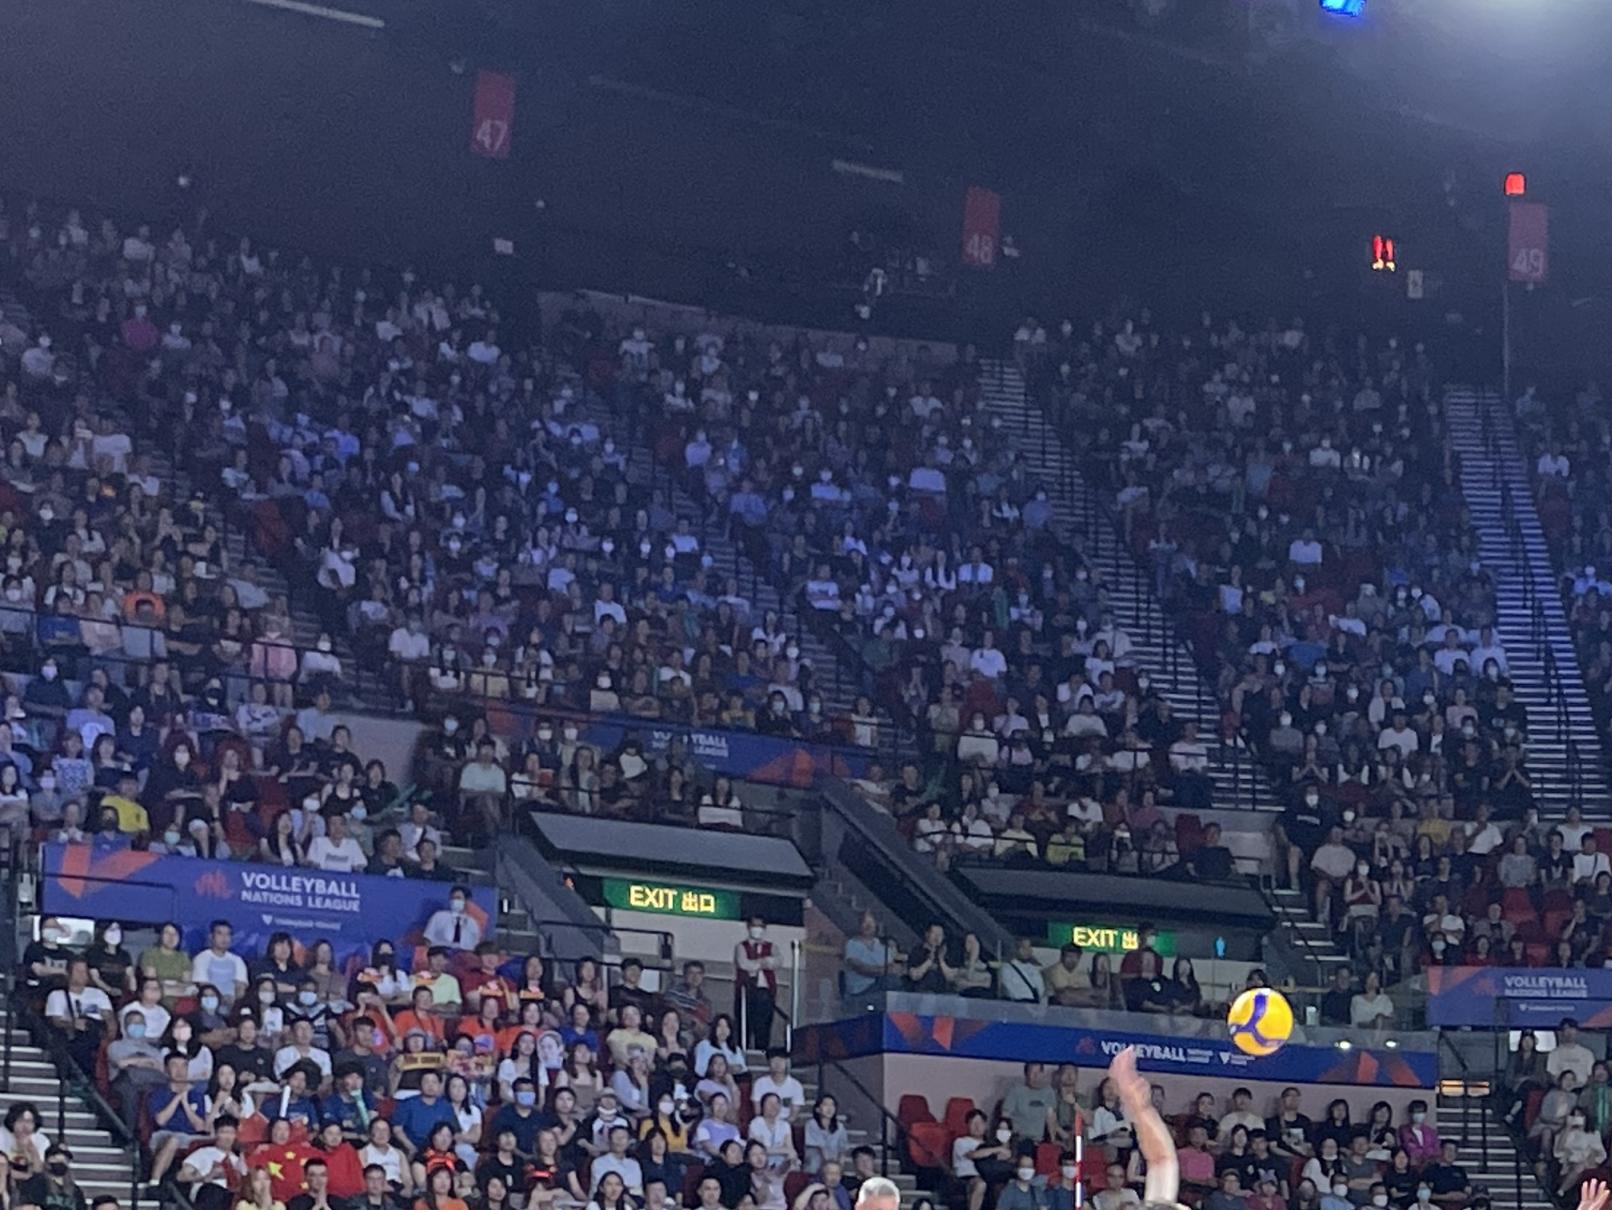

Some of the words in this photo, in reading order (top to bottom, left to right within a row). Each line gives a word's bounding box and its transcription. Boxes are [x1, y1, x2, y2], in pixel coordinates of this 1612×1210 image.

[241, 871, 361, 899] VOLLEYBALL
[241, 889, 303, 907] NATIONS
[307, 895, 361, 912] LEAGUE
[629, 885, 678, 909] EXIT
[681, 890, 715, 913] 出口
[1072, 926, 1118, 948] EXIT
[1504, 975, 1588, 989] VOLLEYBALL
